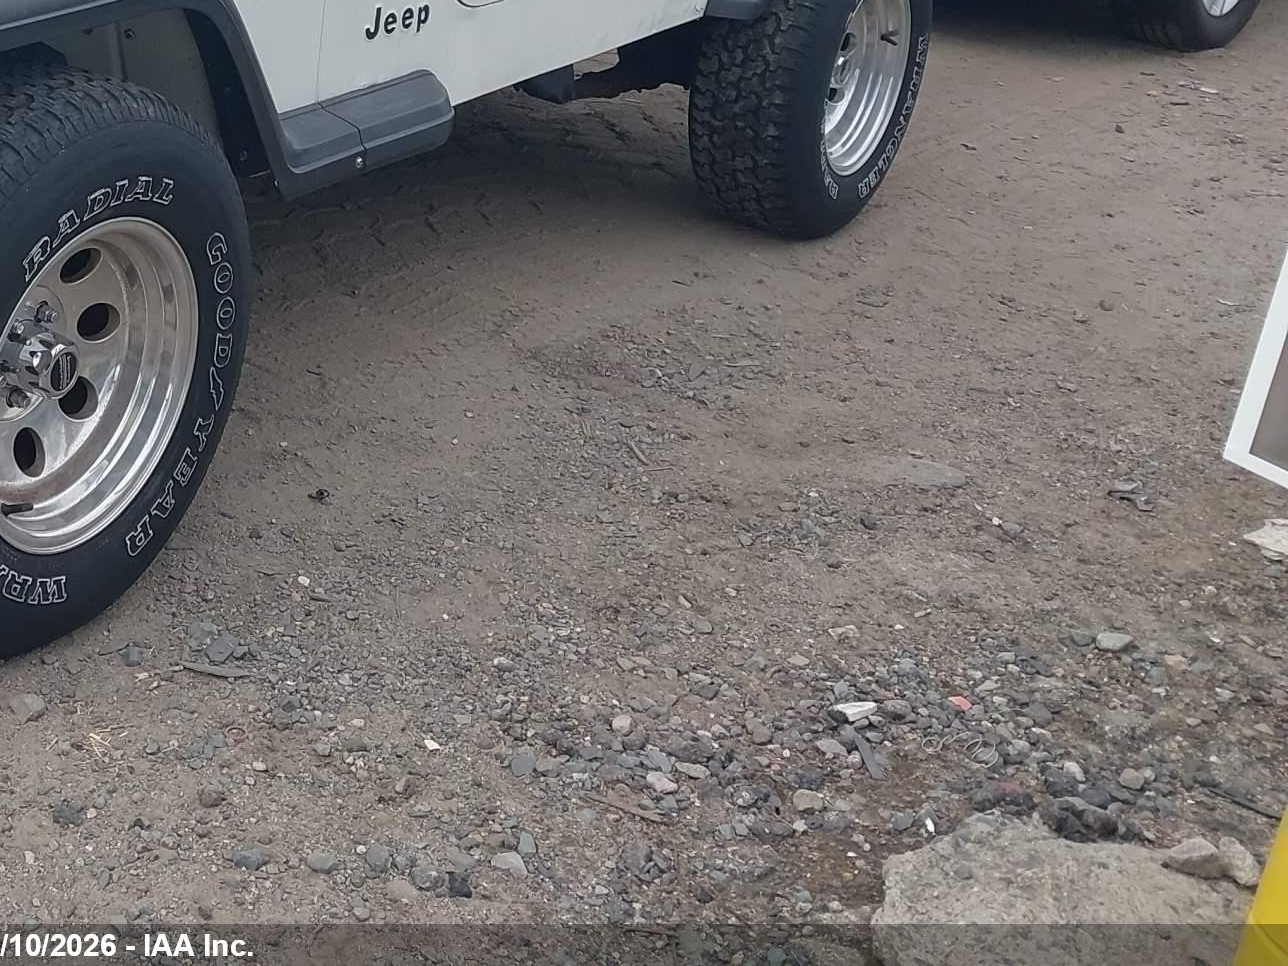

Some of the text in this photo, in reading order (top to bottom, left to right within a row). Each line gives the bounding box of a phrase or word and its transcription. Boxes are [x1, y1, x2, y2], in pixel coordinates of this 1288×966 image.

[364, 3, 430, 41] Jeep
[858, 34, 929, 199] WRANGLER
[23, 175, 176, 282] RADIAL
